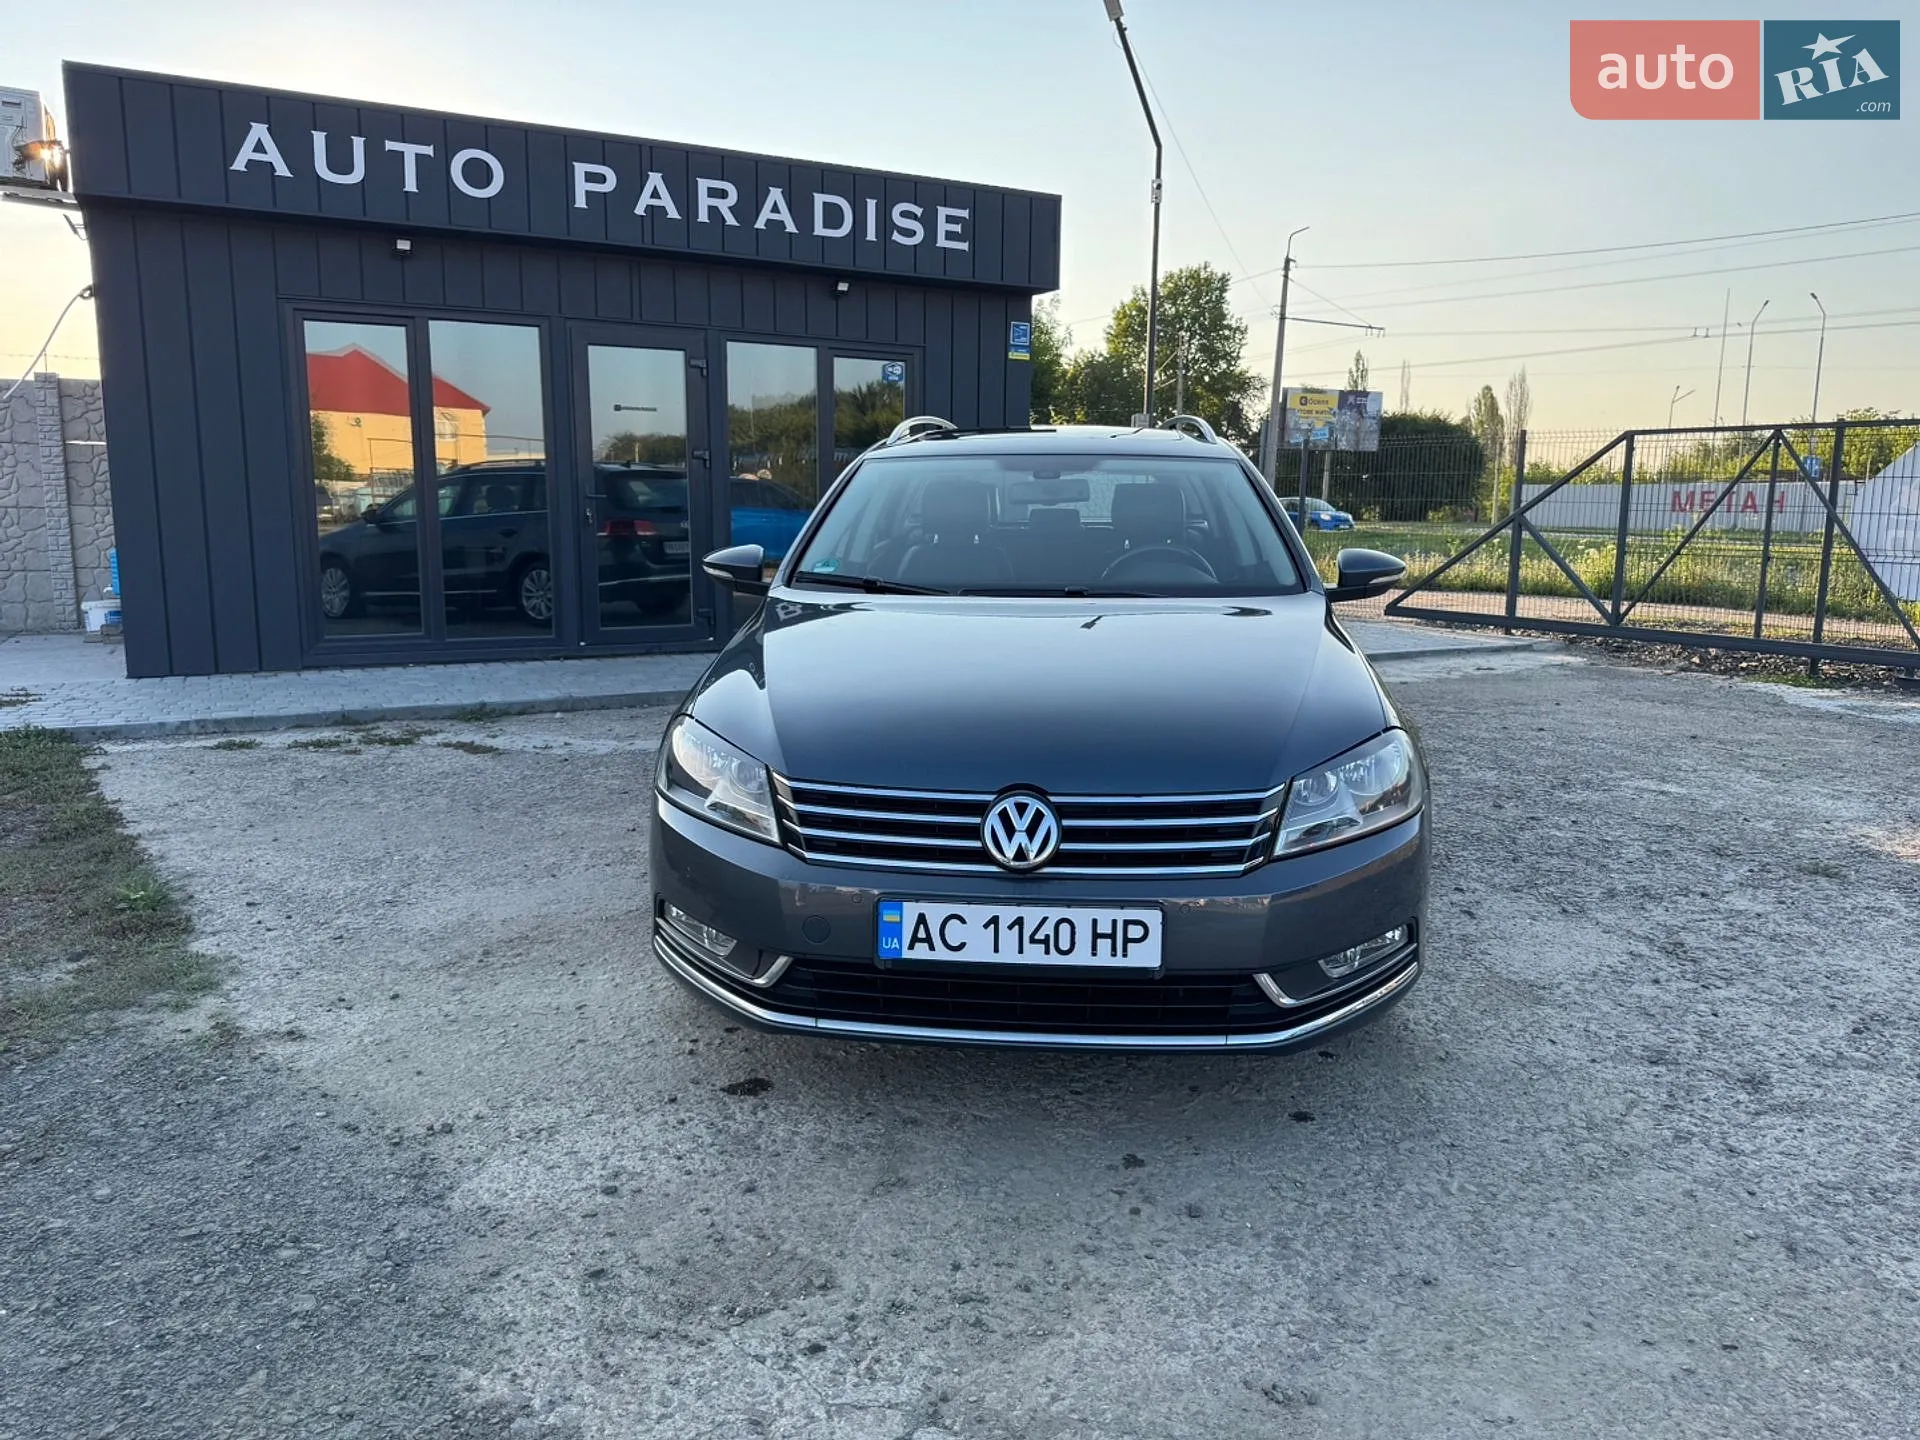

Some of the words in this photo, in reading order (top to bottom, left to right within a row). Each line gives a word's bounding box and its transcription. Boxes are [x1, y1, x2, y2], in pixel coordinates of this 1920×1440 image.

[230, 122, 504, 198] AUTO
[573, 161, 970, 251] PARADISE
[882, 937, 900, 950] UA
[907, 912, 967, 952] AC
[982, 915, 1076, 956] 1140
[1091, 918, 1150, 958] HP
